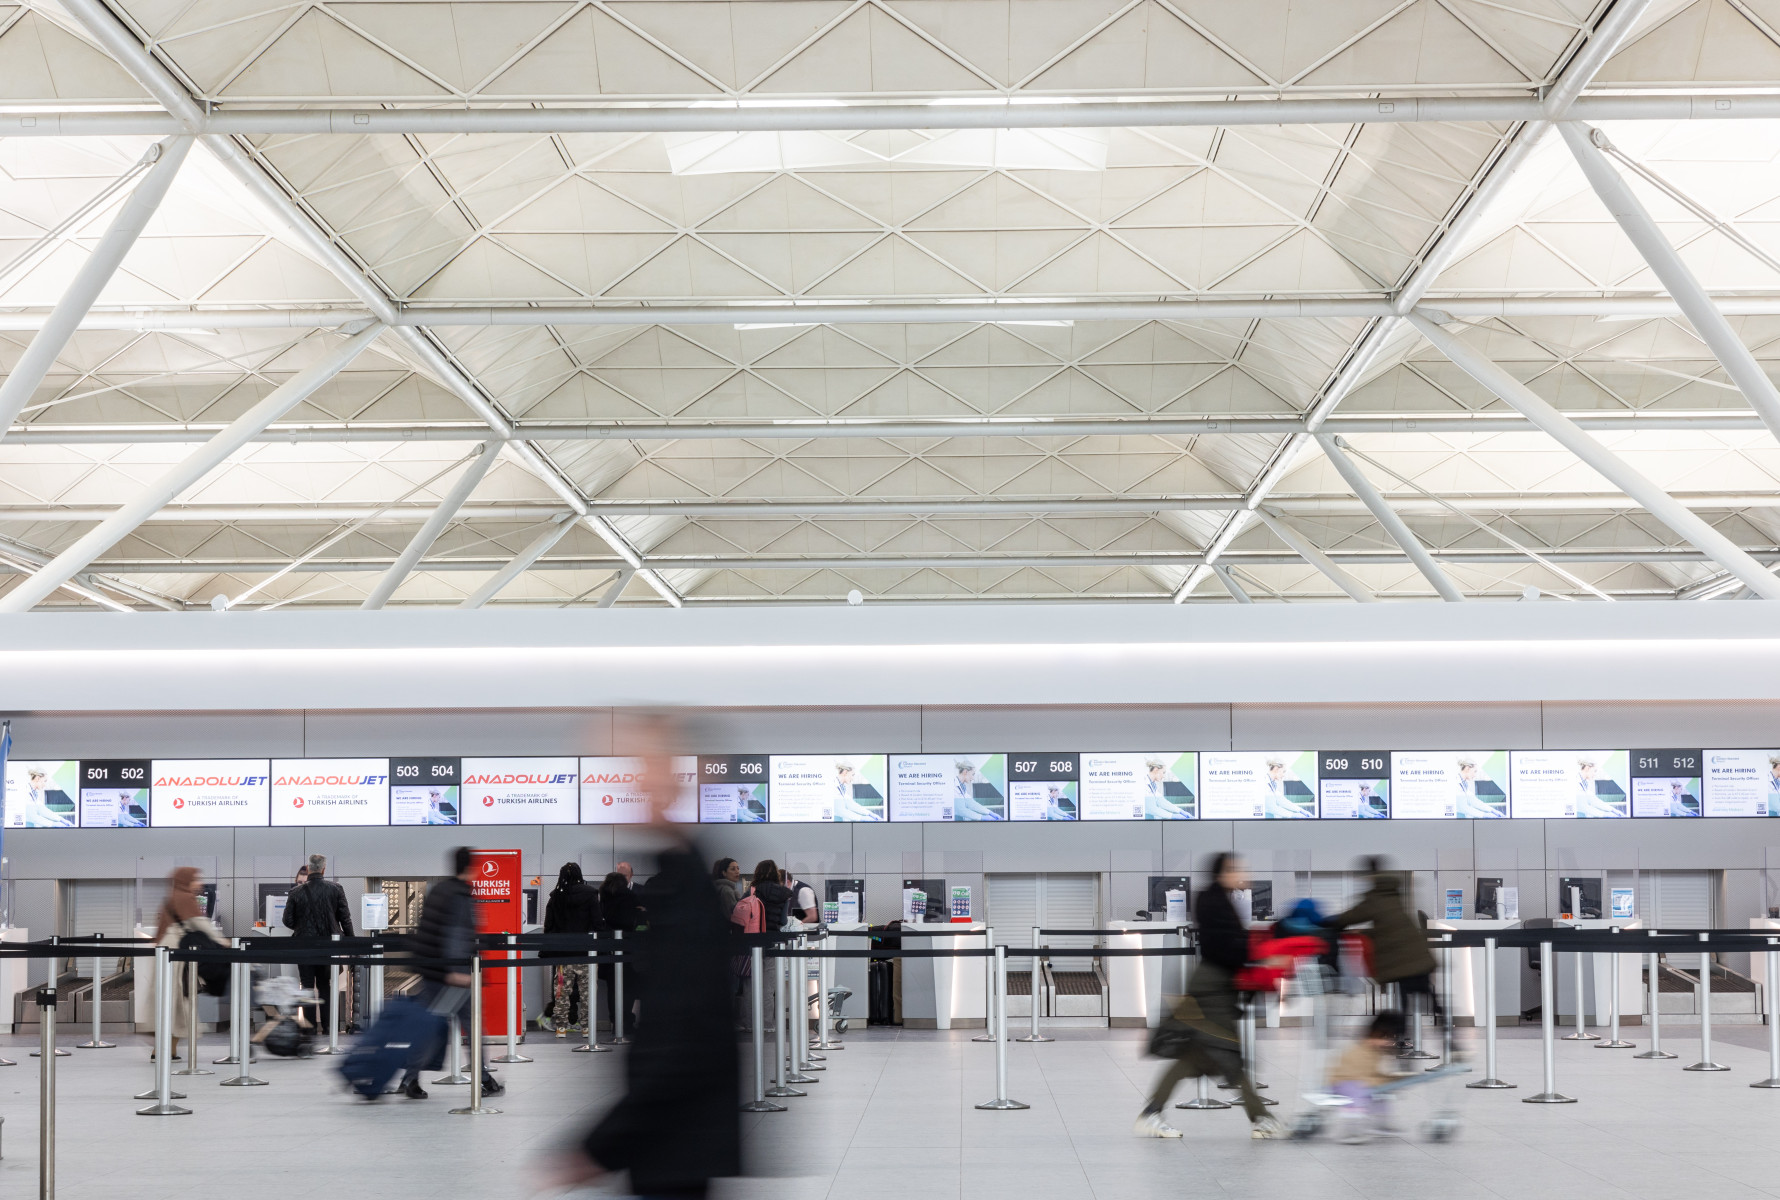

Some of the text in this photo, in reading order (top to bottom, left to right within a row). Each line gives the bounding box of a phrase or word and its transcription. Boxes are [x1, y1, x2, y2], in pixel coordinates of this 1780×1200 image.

[740, 763, 763, 774] 506
[1015, 761, 1038, 773] 507
[1049, 761, 1073, 773] 508
[1325, 758, 1349, 770] 509
[1361, 758, 1383, 770] 510
[1639, 757, 1659, 769] 511
[1673, 757, 1695, 769] 512
[87, 768, 108, 779] 501
[121, 768, 144, 779] 502
[396, 765, 419, 777] 503
[431, 765, 454, 776] 504
[705, 763, 728, 775] 505
[153, 776, 268, 787] ANADOLUJET
[273, 775, 388, 786] ANADOLUJET
[463, 774, 577, 784] ANADOLUJET
[471, 880, 510, 888] TURKISH
[471, 888, 511, 896] AIRLINES
